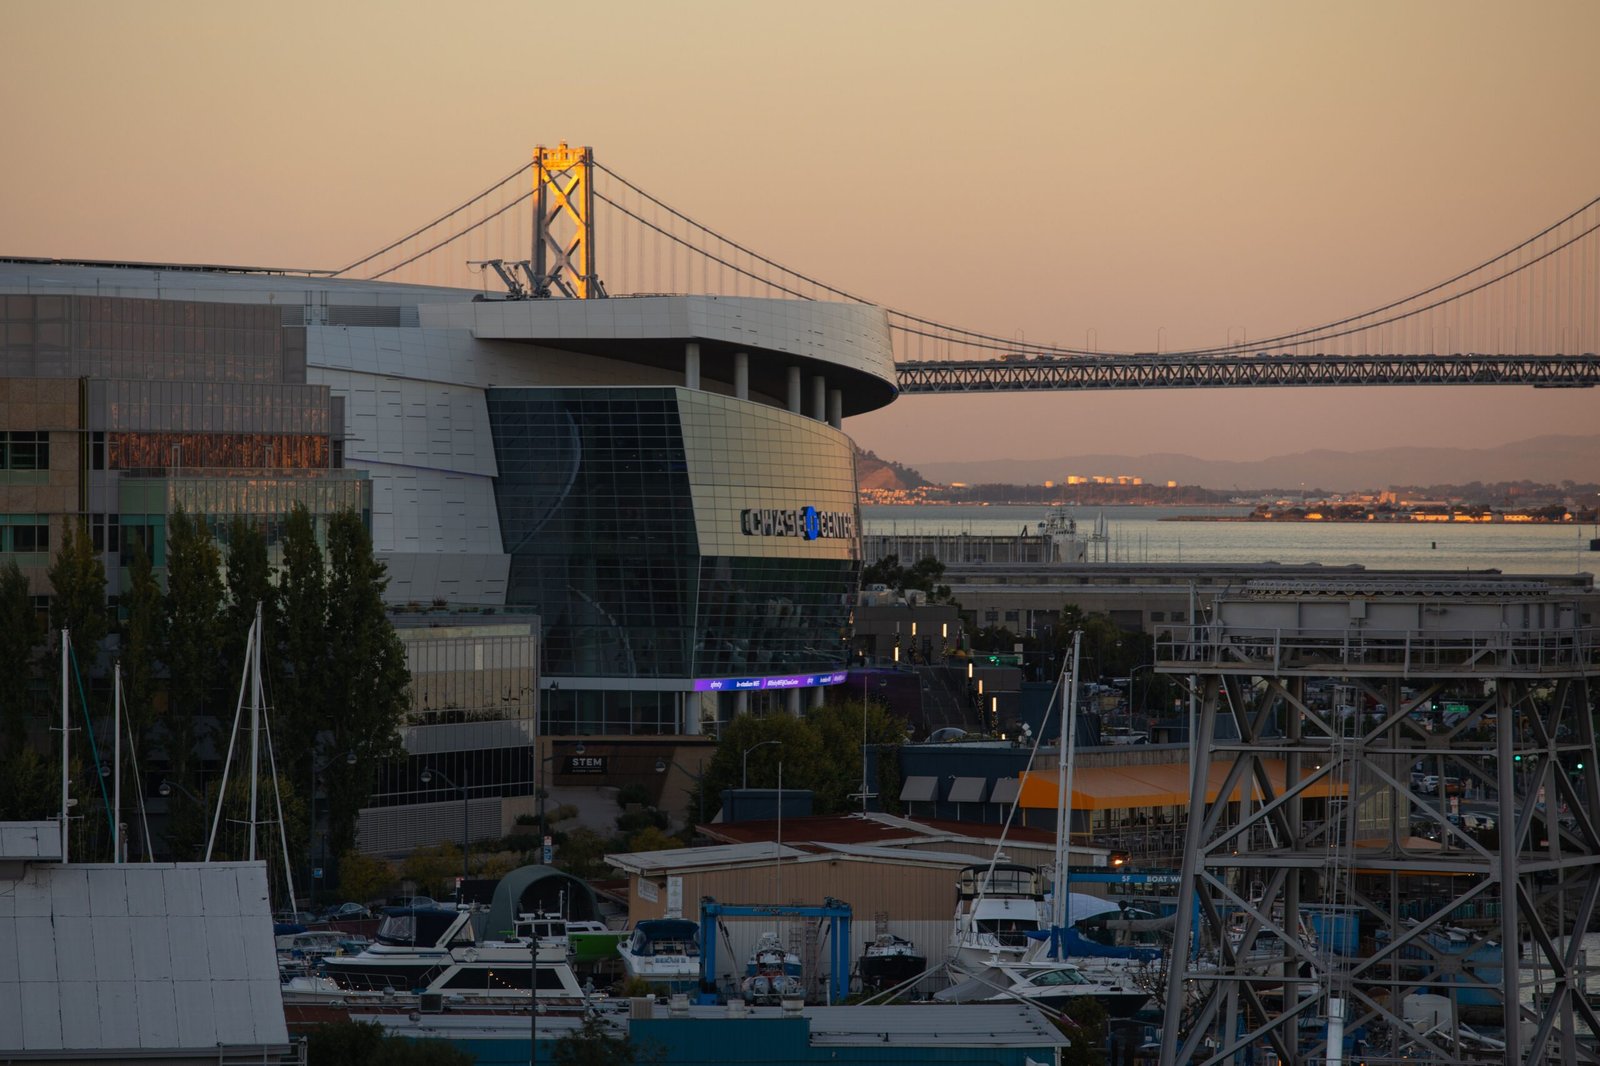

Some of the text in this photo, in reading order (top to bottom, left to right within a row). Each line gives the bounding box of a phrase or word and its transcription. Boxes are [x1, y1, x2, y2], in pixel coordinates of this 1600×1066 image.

[742, 509, 856, 538] CHASE CENTER
[572, 757, 602, 766] STEM
